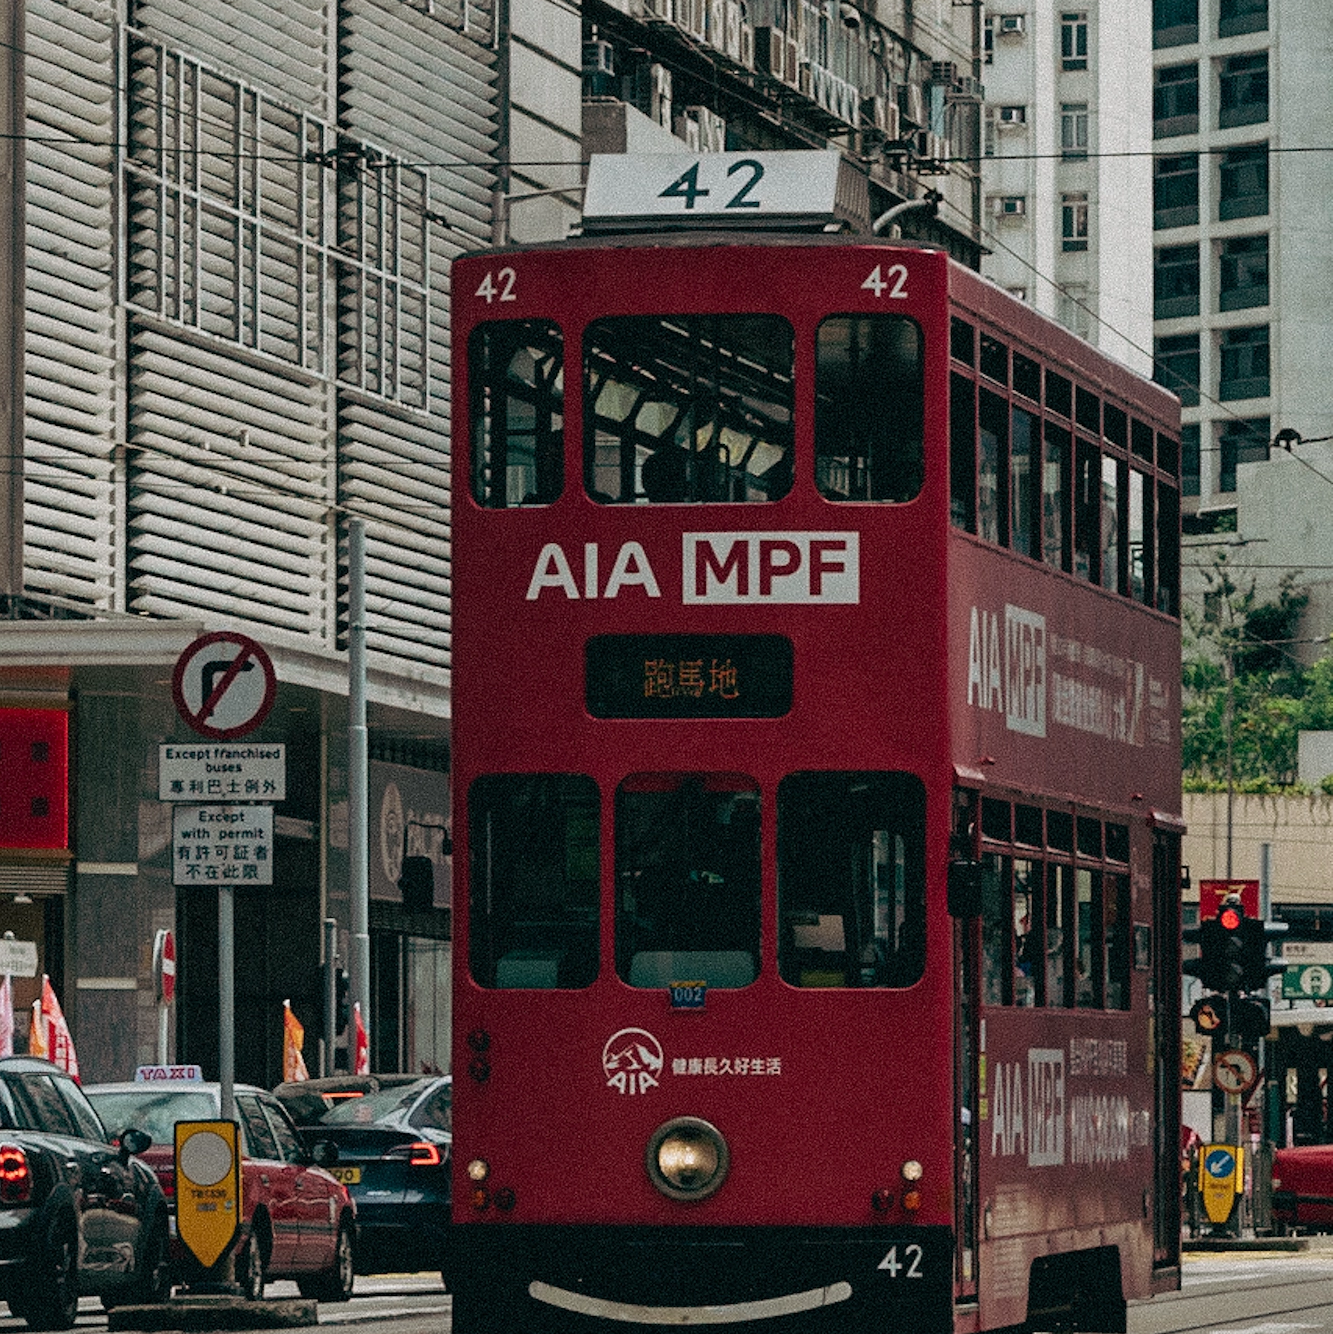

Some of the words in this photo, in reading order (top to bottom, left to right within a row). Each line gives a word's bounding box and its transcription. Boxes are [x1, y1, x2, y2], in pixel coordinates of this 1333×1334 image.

[657, 159, 764, 209] 42
[475, 267, 517, 304] 42
[861, 264, 909, 299] 42
[525, 541, 662, 600] AIA
[695, 540, 847, 597] MPF
[967, 605, 1003, 714] AIA
[1008, 618, 1045, 722] MPF
[644, 659, 740, 699] 跑馬地
[166, 748, 210, 761] Except
[214, 748, 280, 760] franchised
[206, 763, 243, 773] buses
[170, 779, 276, 794] 專利巴士例外
[199, 811, 245, 823] Except
[181, 827, 209, 839] with
[219, 828, 264, 840] permit
[186, 864, 259, 879] 不在此限
[674, 986, 703, 1002] 002
[140, 1068, 196, 1080] TAXI
[671, 1057, 782, 1076] 健康長久好生活
[607, 1071, 659, 1096] AIA
[991, 1062, 1025, 1157] AIA
[877, 1244, 924, 1278] 42
